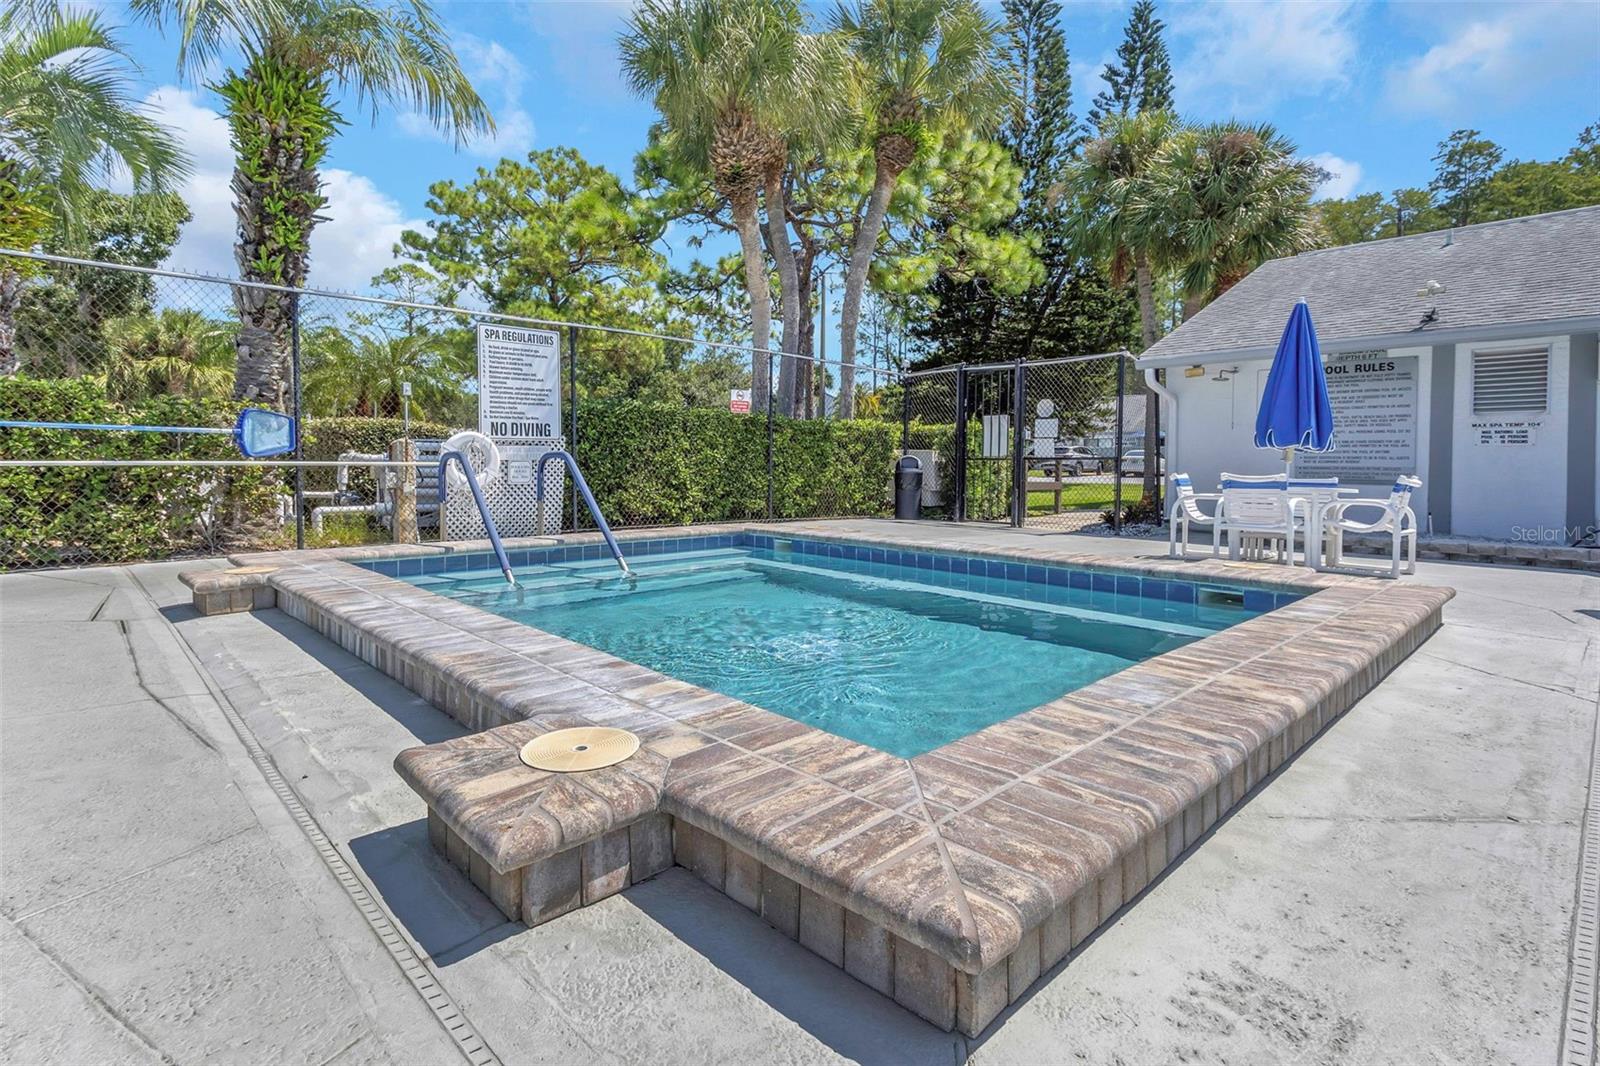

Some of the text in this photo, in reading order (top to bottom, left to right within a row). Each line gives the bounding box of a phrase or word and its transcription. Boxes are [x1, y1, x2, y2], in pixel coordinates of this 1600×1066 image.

[484, 328, 554, 346] SPA REGULATIONS
[1324, 361, 1395, 375] OOL RULES
[490, 421, 551, 437] NO DIVING
